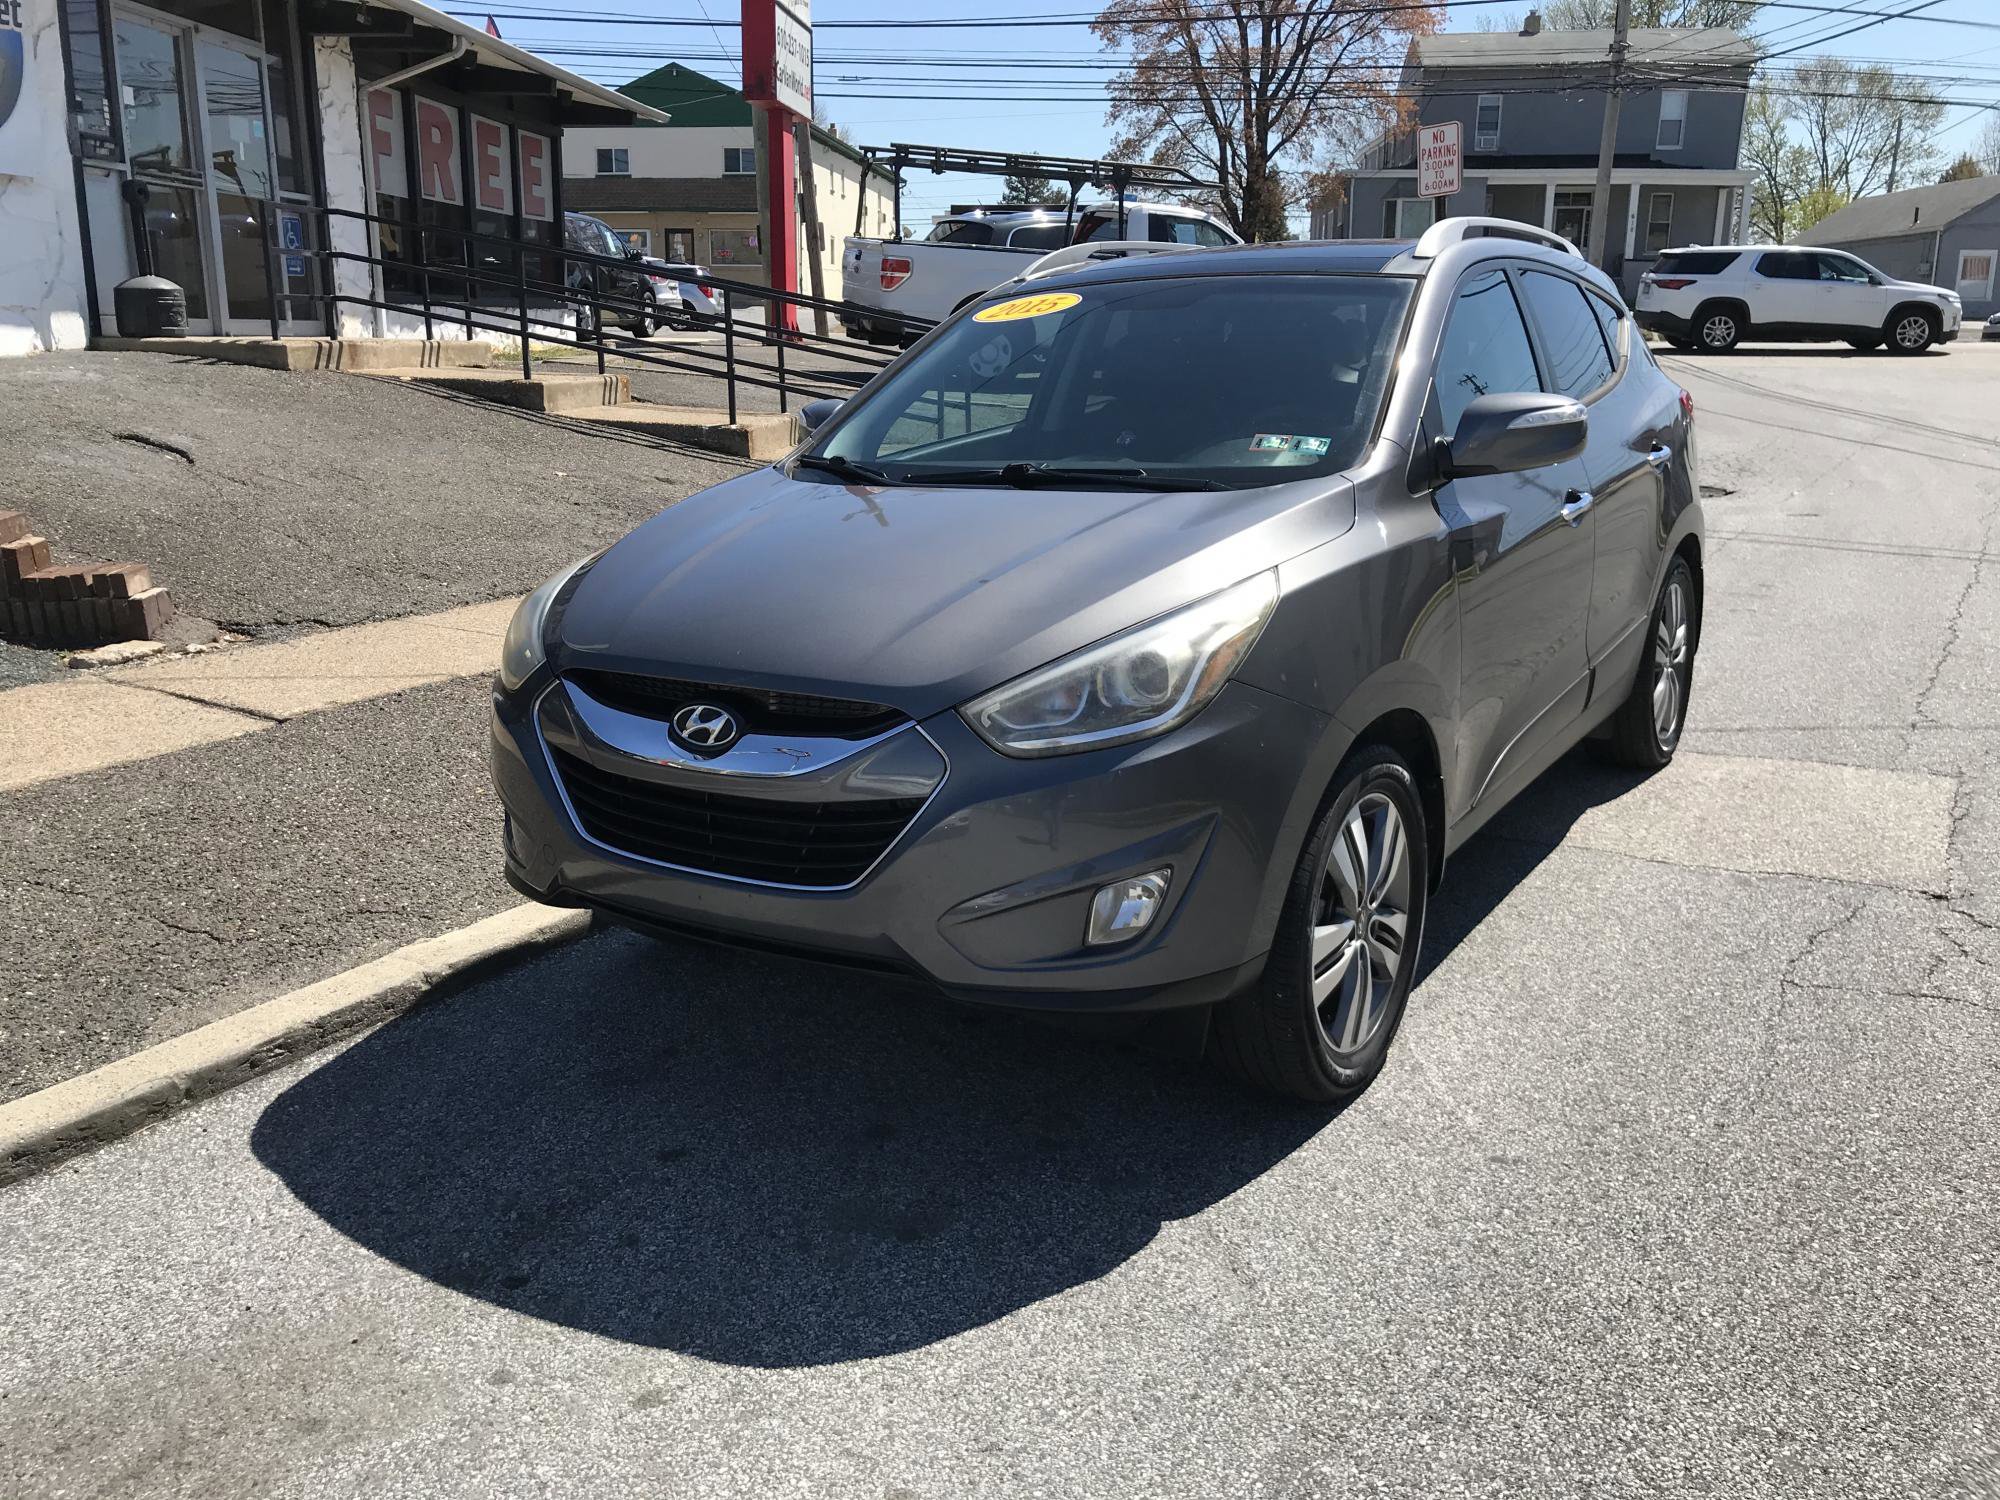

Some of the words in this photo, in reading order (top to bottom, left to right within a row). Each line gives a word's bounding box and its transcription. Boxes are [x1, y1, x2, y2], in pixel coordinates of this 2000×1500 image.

[1432, 130, 1445, 144] NO
[368, 88, 546, 218] FREE
[1421, 144, 1456, 161] PARKING
[1425, 159, 1454, 171] 3:00AM
[1435, 170, 1444, 179] TO
[1425, 179, 1454, 191] 6:00AM
[985, 296, 1069, 319] 2015
